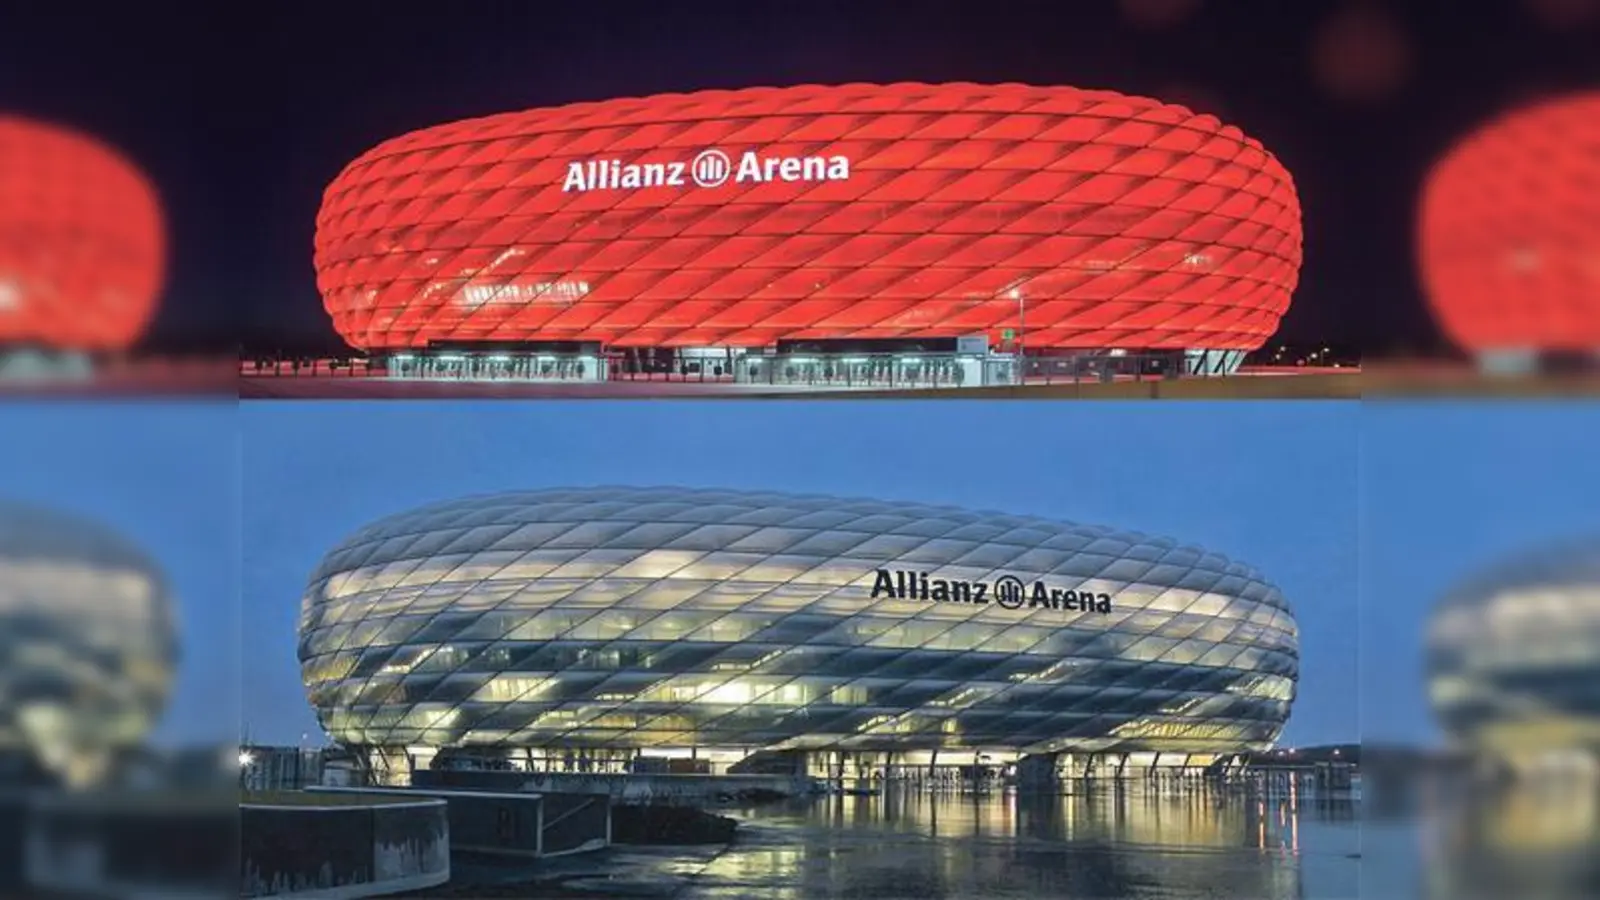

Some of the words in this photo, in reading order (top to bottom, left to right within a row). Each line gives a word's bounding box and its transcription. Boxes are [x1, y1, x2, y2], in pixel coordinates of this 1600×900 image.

[563, 160, 685, 192] Allianz
[736, 152, 849, 183] Arena
[871, 569, 989, 604] Allianz
[1029, 581, 1112, 614] Arena
